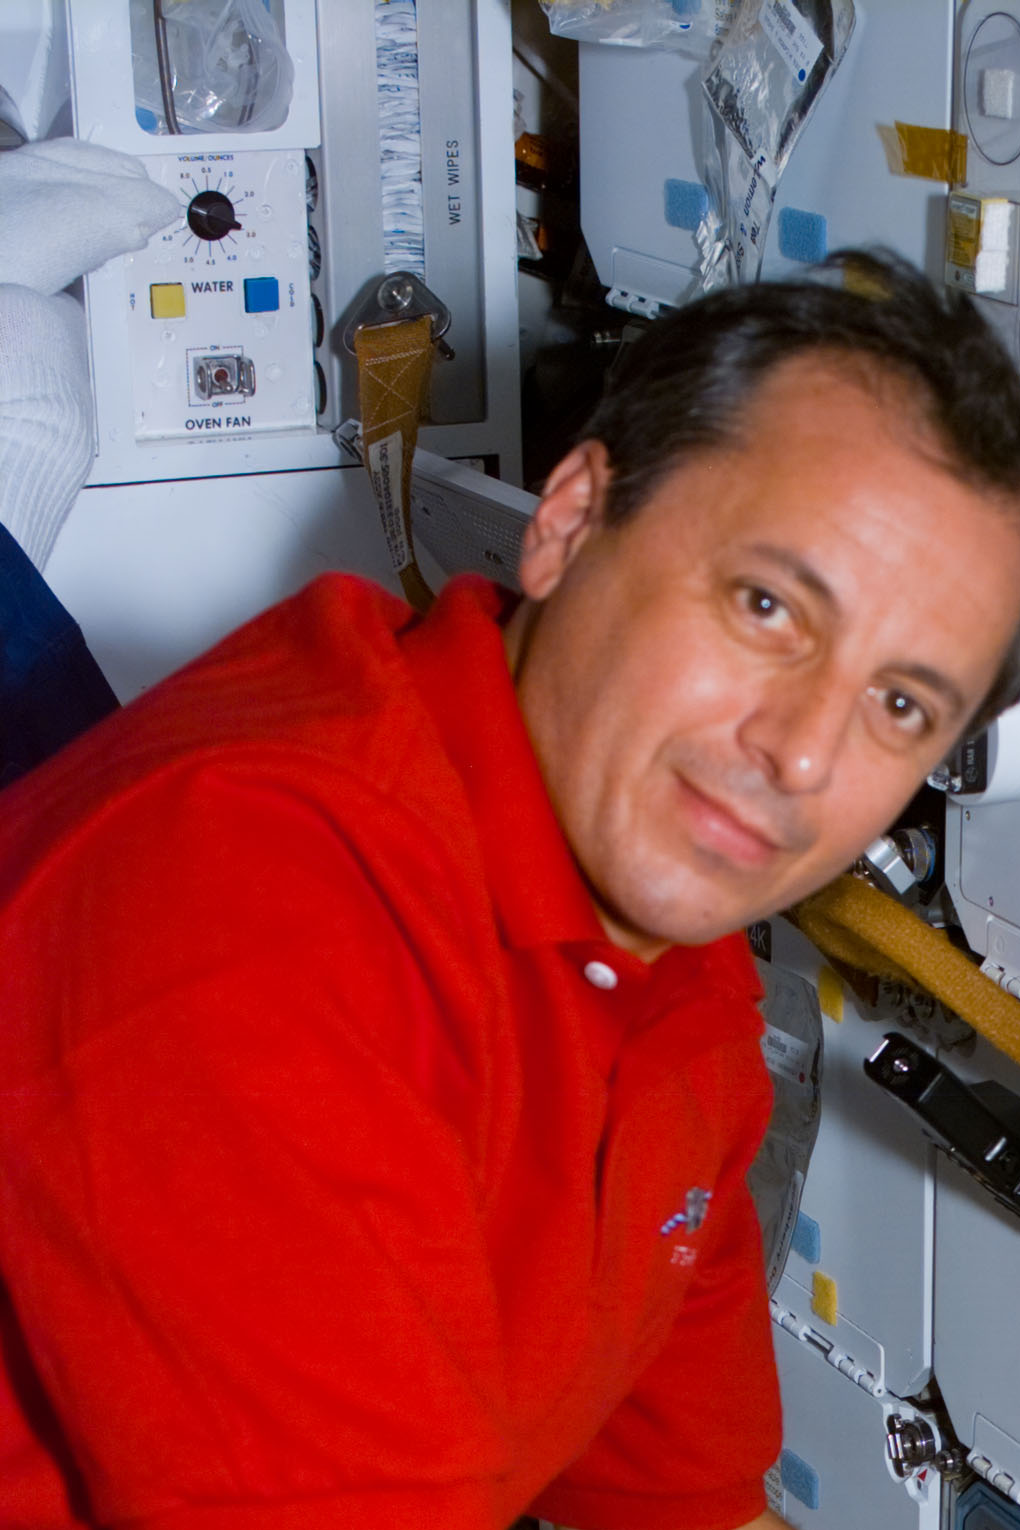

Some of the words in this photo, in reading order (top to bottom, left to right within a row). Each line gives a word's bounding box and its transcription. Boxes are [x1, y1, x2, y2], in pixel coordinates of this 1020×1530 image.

[446, 140, 459, 186] WIPES
[448, 195, 461, 225] WET
[191, 281, 234, 293] WATER
[185, 419, 222, 430] OVEN
[226, 416, 251, 428] FAN
